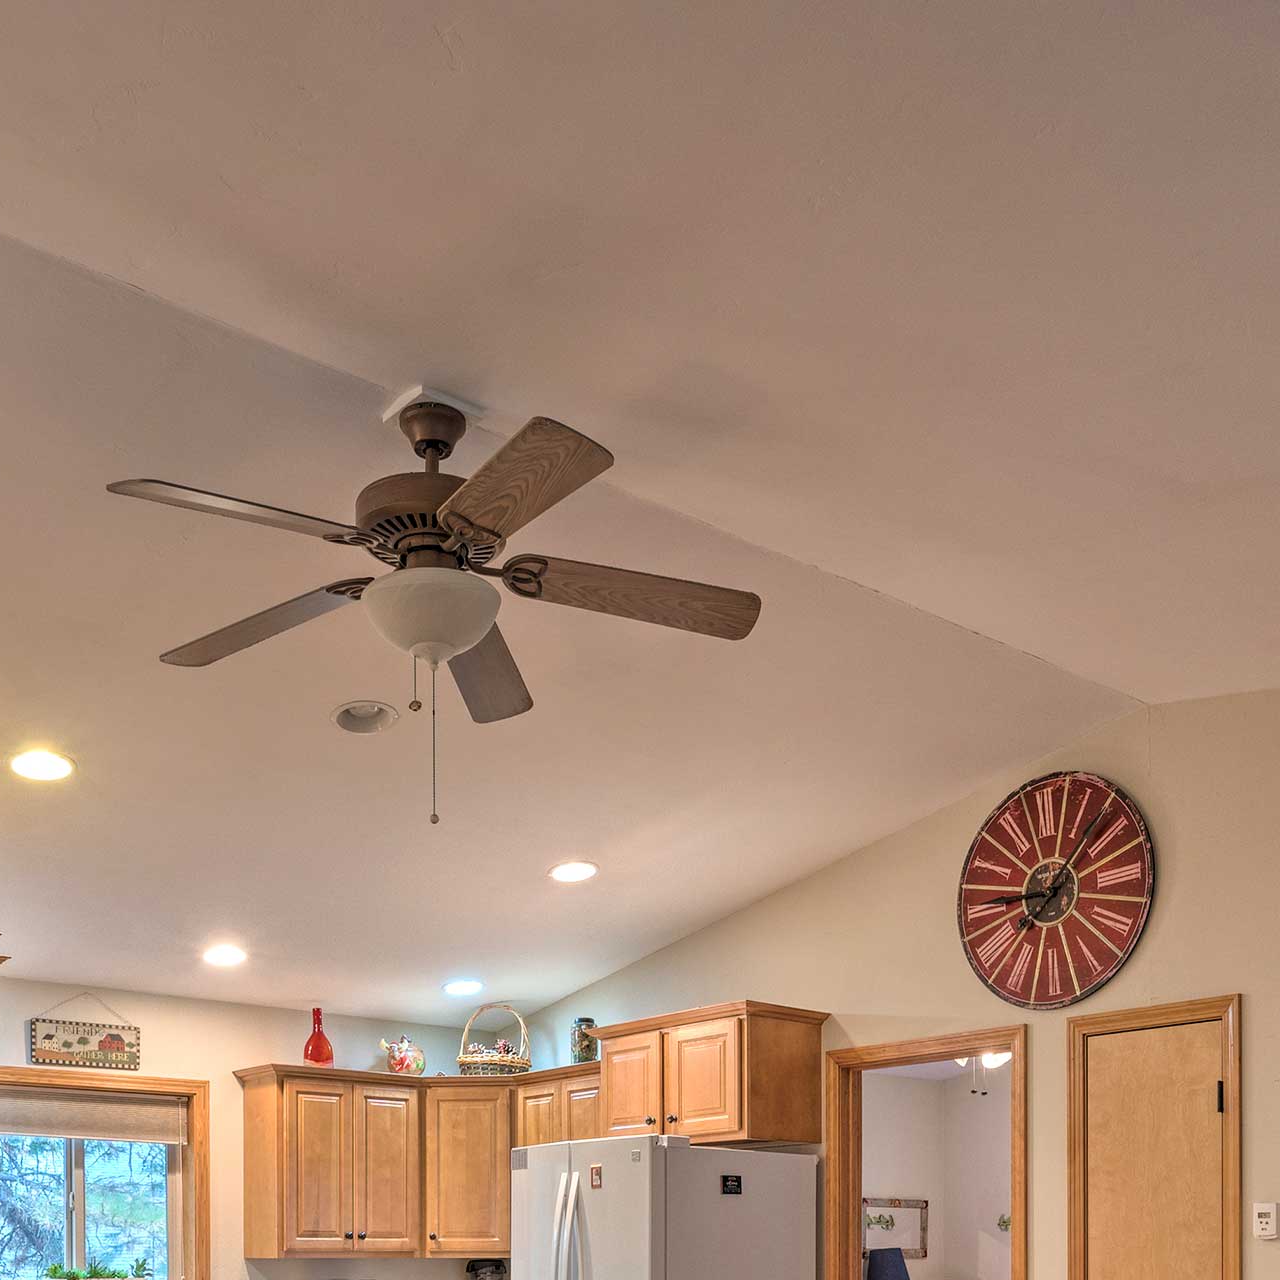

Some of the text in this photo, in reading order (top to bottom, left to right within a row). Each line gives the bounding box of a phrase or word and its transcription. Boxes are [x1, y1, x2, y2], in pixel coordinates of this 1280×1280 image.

[1033, 787, 1057, 839] XII
[997, 810, 1031, 858] XI
[972, 856, 1012, 881] X
[1096, 860, 1141, 890] III
[975, 920, 1017, 970] VIII
[108, 1052, 130, 1061] HERE
